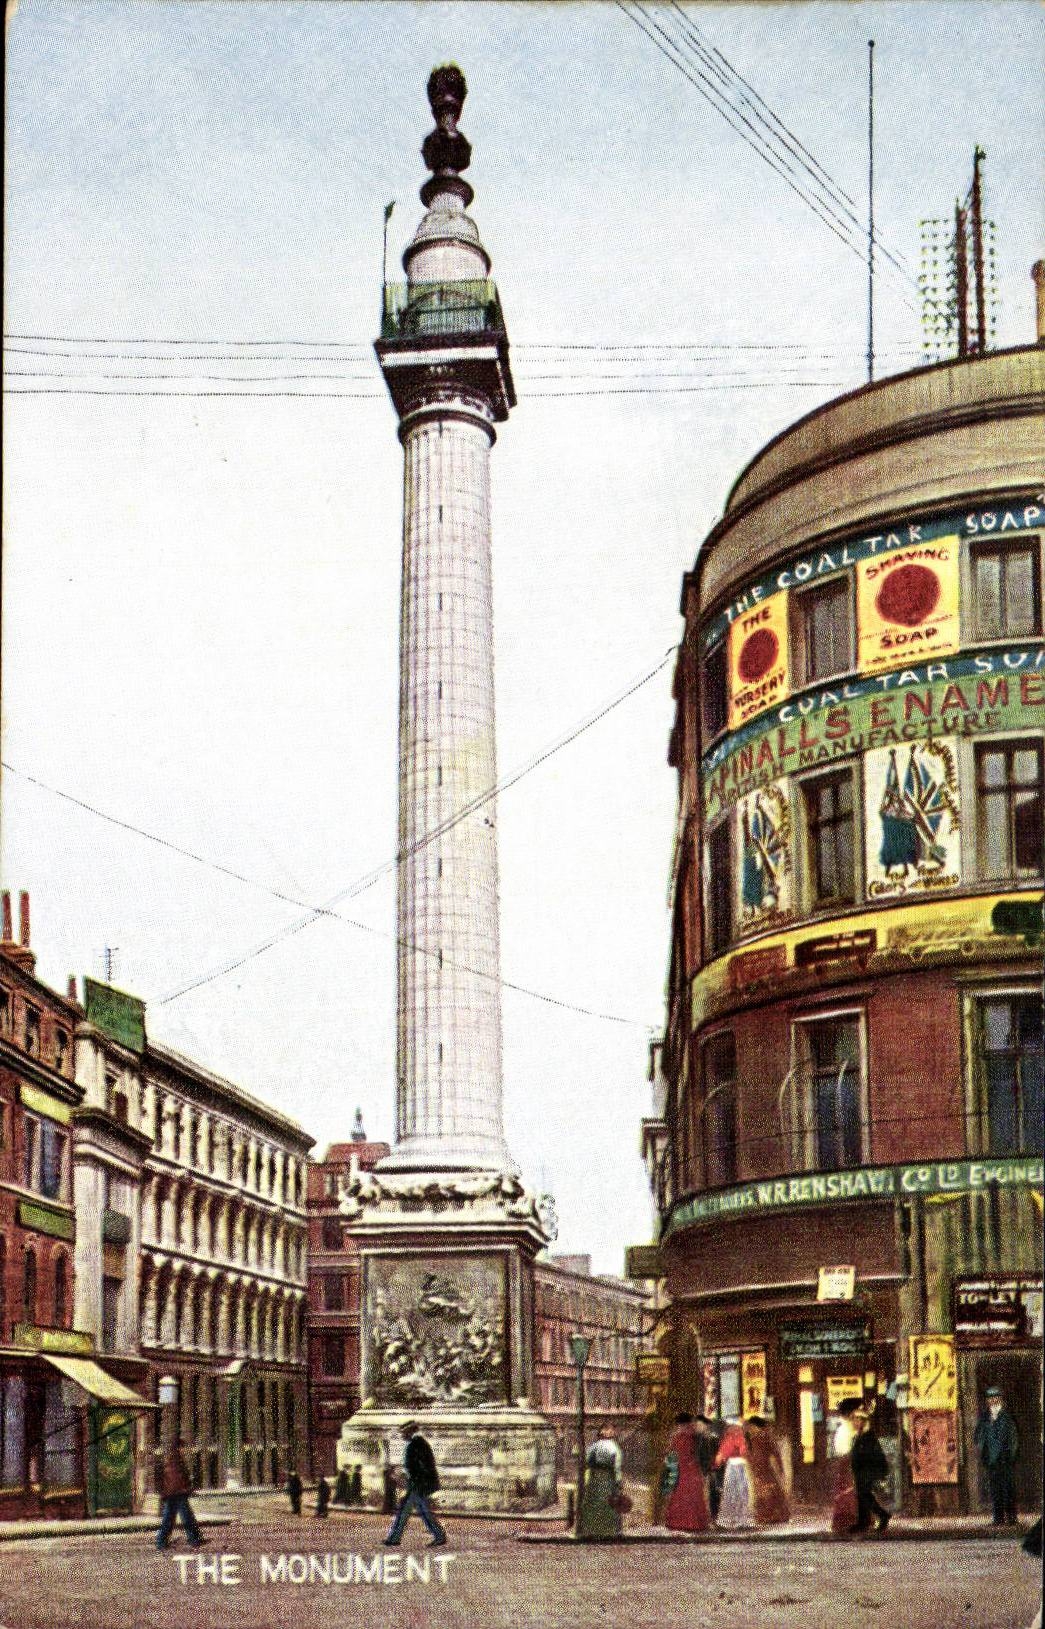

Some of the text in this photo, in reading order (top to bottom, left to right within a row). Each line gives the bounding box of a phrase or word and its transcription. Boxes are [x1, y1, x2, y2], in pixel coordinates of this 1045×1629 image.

[724, 586, 763, 624] THE
[777, 546, 856, 589] COAL
[965, 505, 1041, 533] SOAP
[865, 546, 950, 580] SHAVING
[741, 606, 771, 634] THE
[881, 626, 938, 650] SOAP
[875, 663, 948, 690] TAR
